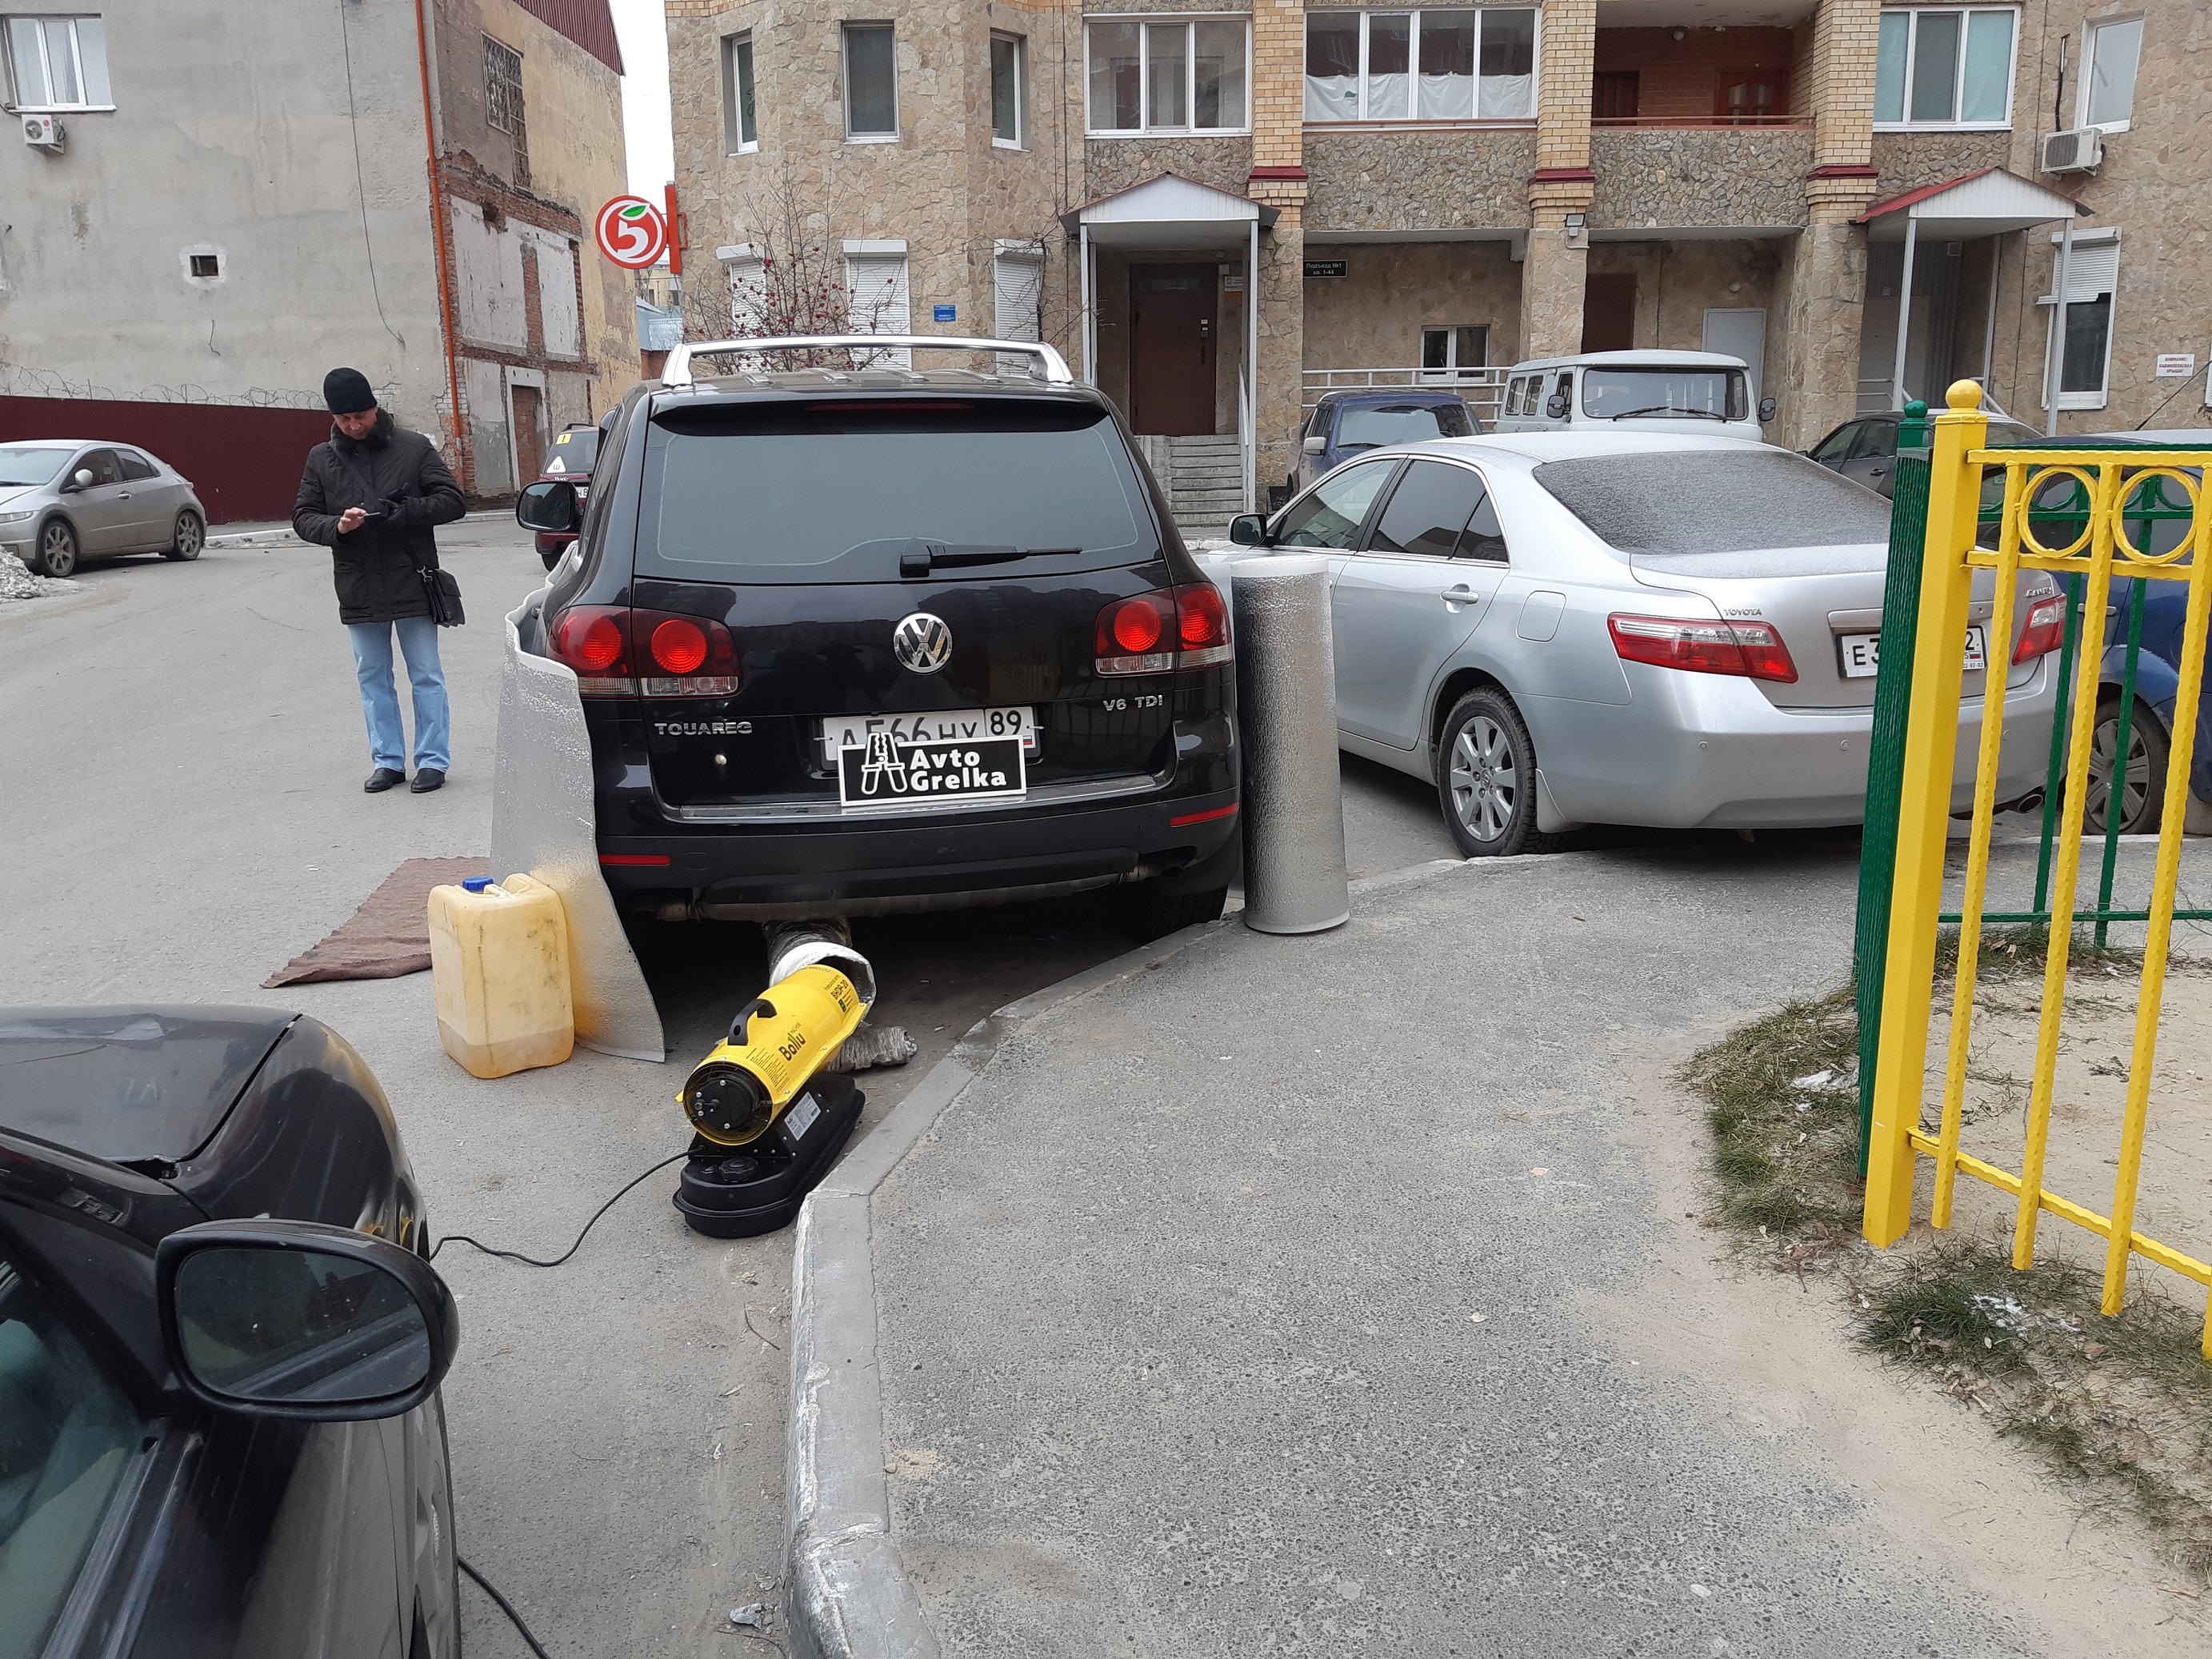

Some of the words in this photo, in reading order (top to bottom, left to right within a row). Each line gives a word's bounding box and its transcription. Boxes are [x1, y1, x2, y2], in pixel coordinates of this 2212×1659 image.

[617, 218, 649, 258] 5
[1102, 698, 1126, 711] V6
[1134, 694, 1162, 709] TDI
[654, 722, 753, 735] TOUAREG
[990, 710, 1022, 736] 89
[778, 1032, 806, 1061] Ballu
